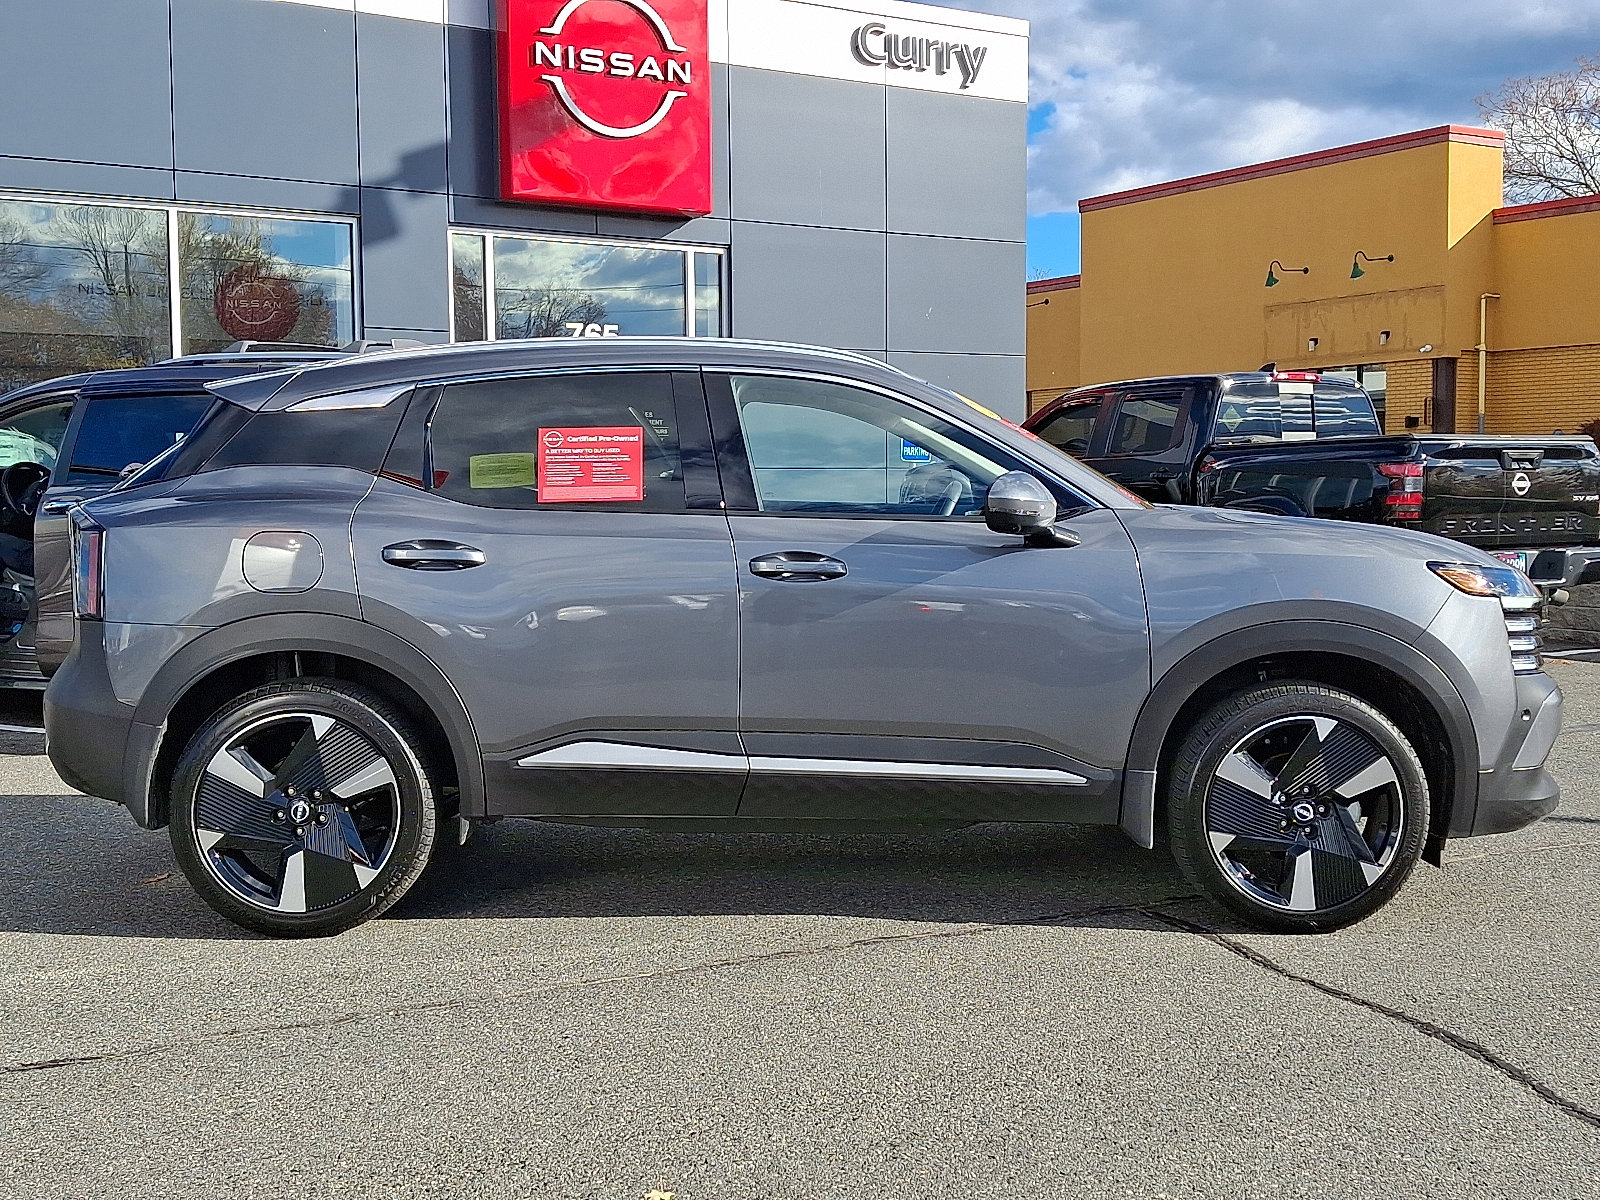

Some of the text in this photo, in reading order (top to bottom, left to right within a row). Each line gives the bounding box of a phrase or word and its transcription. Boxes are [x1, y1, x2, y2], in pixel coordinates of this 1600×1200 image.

[532, 41, 692, 84] NISSAN
[850, 22, 988, 89] Curry
[78, 282, 139, 297] NISSAN
[225, 299, 282, 309] NISSAN
[565, 322, 619, 338] 765
[903, 446, 929, 456] PARKING
